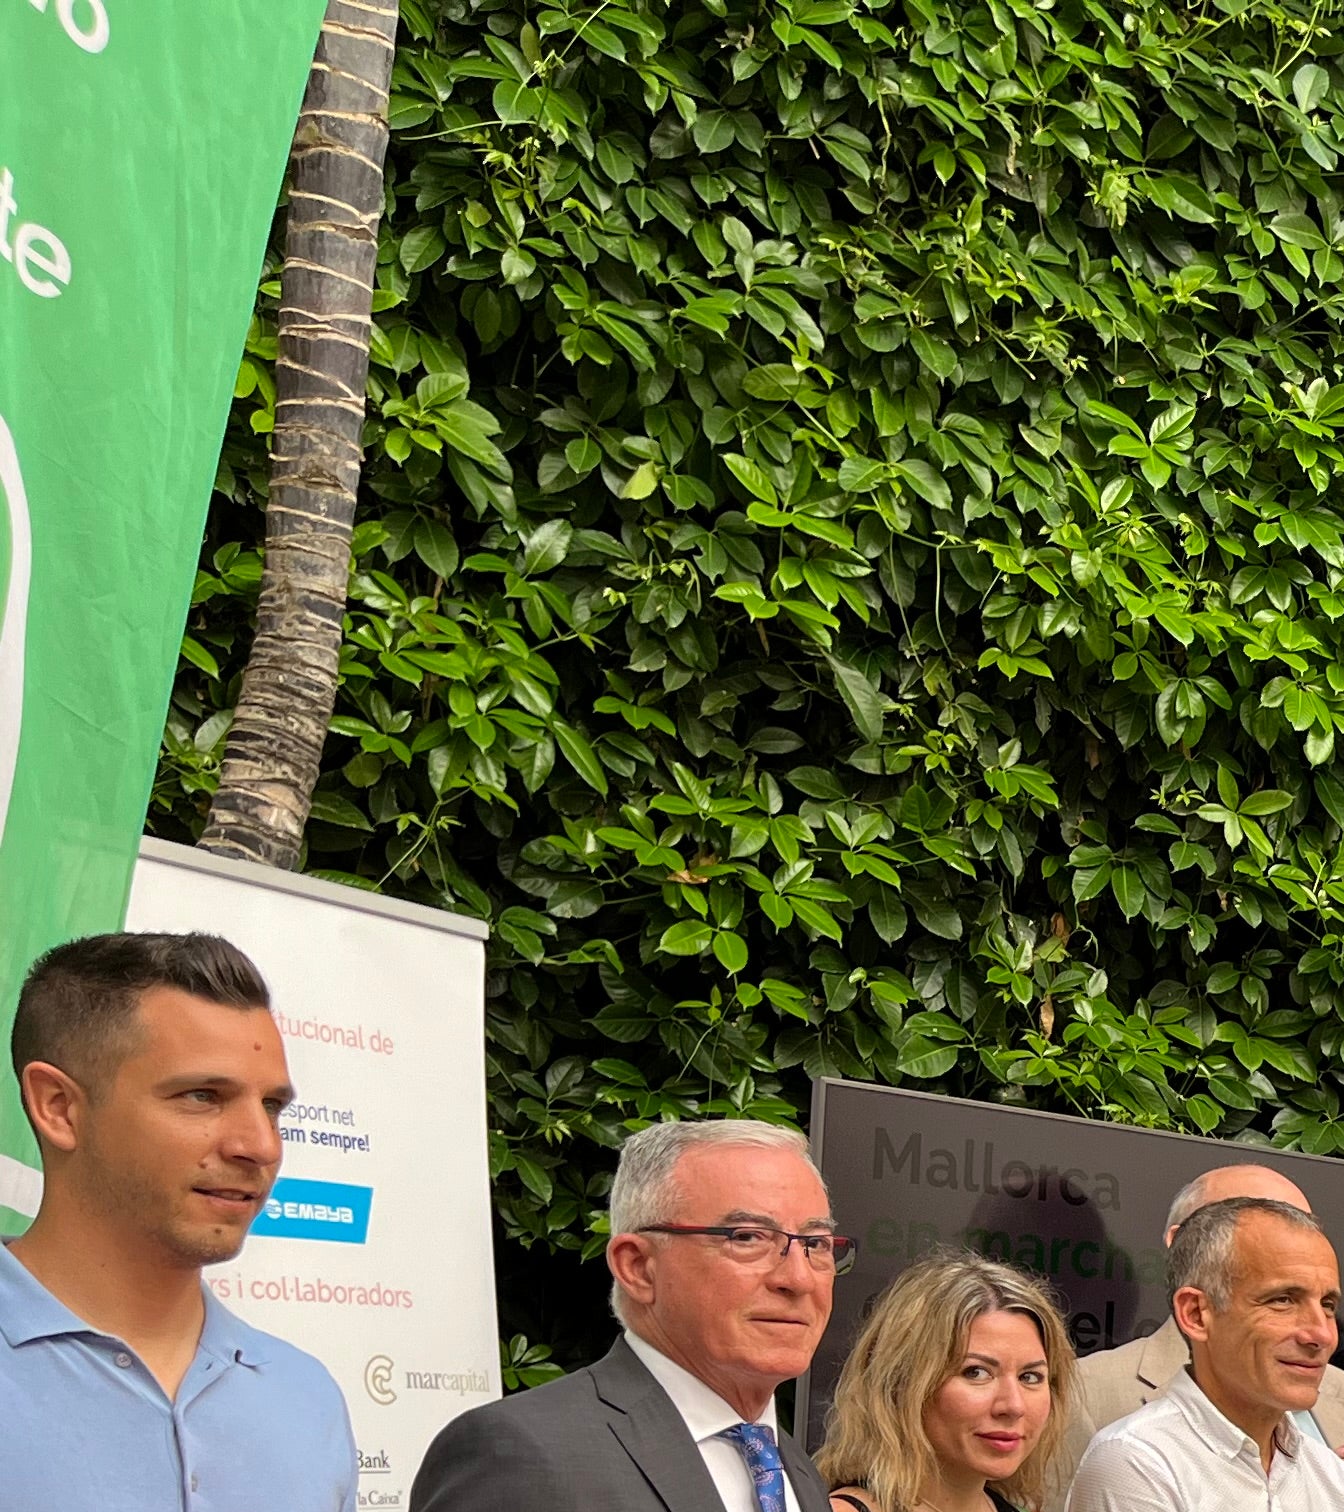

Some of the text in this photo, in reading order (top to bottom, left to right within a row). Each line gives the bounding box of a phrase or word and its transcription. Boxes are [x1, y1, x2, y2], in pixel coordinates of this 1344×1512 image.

[272, 1010, 394, 1055] tucional de
[332, 1109, 355, 1127] net
[310, 1129, 370, 1153] sempre!
[872, 1126, 1121, 1211] Mallorca
[209, 1276, 231, 1299] rs
[406, 1369, 490, 1396] marcapital
